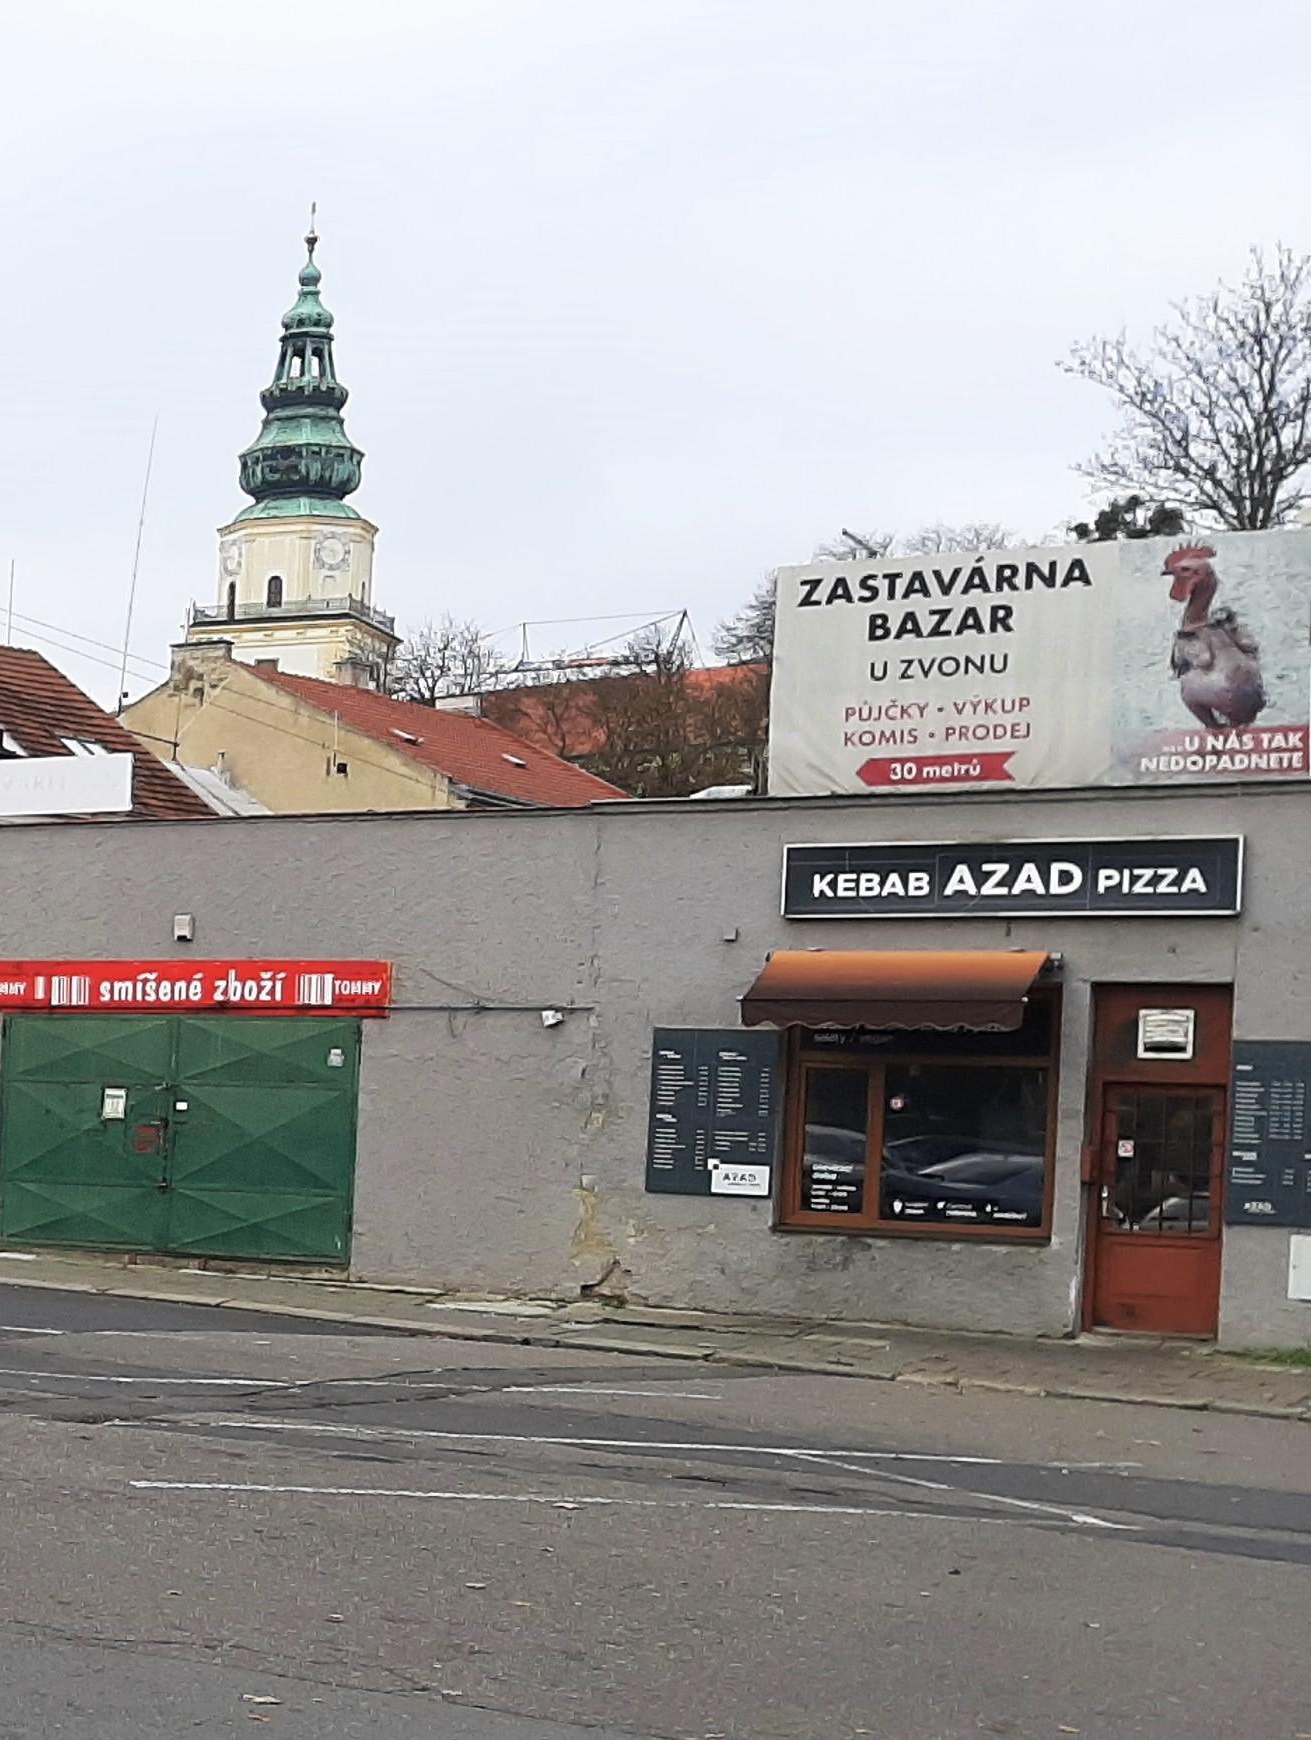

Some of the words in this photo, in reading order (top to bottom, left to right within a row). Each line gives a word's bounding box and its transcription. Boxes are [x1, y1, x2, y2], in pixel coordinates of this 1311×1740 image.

[797, 556, 1092, 608] ZASTAVÁRNA
[867, 604, 1015, 642] BAZAR
[870, 661, 888, 681] U
[898, 653, 1008, 680] ZVONU
[845, 699, 929, 722] PŮJČKY
[953, 694, 1031, 715] VÝKUP
[844, 728, 919, 747] KOMIS
[945, 723, 1031, 742] PRODEJ
[1206, 730, 1254, 751] NÁS
[1260, 732, 1304, 749] TAK
[889, 762, 917, 780] 30
[922, 758, 981, 778] metrů
[1141, 752, 1304, 772] NEDOPADNETE
[812, 872, 930, 898] KEBAB
[943, 863, 1083, 896] AZAD
[1097, 867, 1208, 895] PIZZA
[99, 972, 204, 1002] smíšené
[213, 969, 287, 1002] zboží
